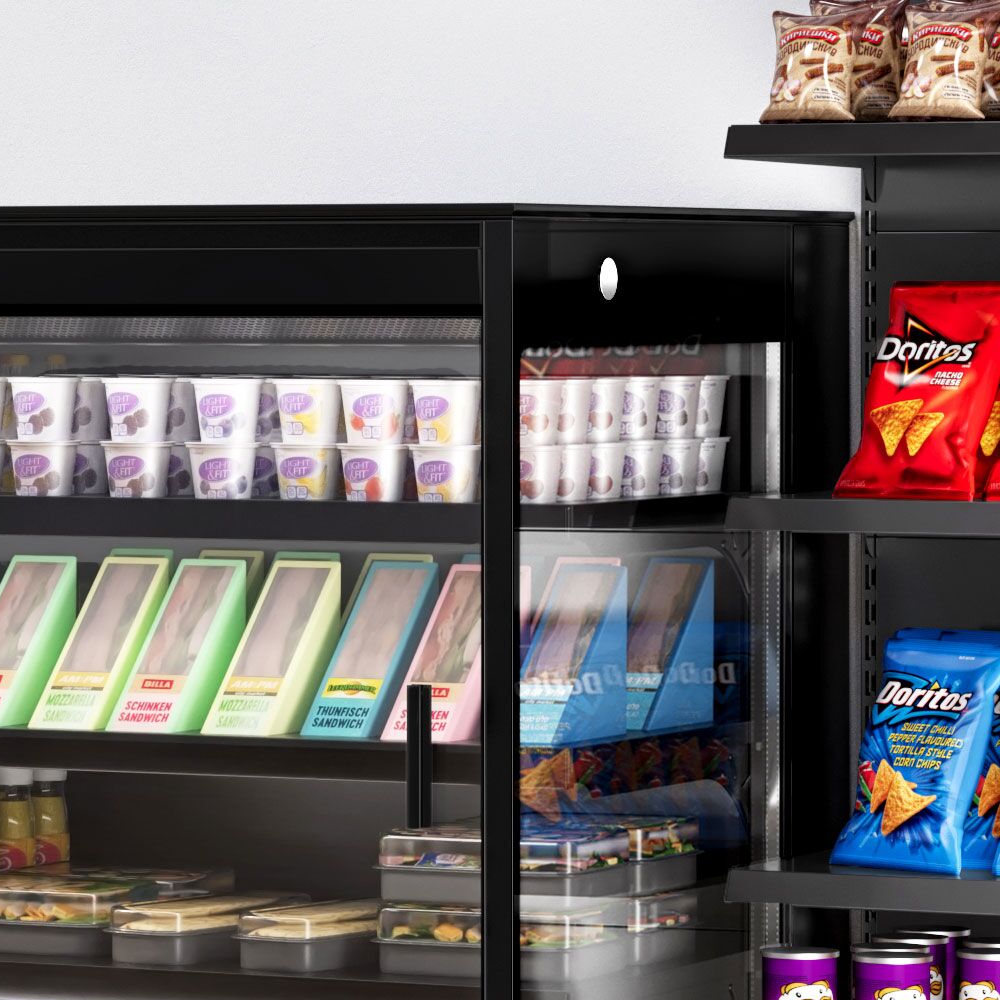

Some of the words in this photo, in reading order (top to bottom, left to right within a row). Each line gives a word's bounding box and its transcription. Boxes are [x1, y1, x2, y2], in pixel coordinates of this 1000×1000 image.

[876, 337, 976, 362] Doritos
[934, 371, 963, 379] NACHO
[929, 378, 961, 386] CHEESE
[143, 680, 173, 689] BILLA
[876, 681, 972, 711] Doritos
[125, 700, 173, 712] SCHINKEN
[316, 705, 370, 718] THUNFISCH
[118, 712, 169, 723] SANDWICH
[311, 717, 363, 730] SANDWICH
[901, 722, 930, 733] SWEET
[930, 724, 956, 735] CHILLI
[888, 733, 916, 744] PEPPER
[917, 735, 963, 748] FLAVOURED
[889, 745, 925, 757] TORTILLA
[926, 748, 953, 760] STYLE
[893, 757, 915, 768] CORN
[916, 759, 942, 770] CHIPS
